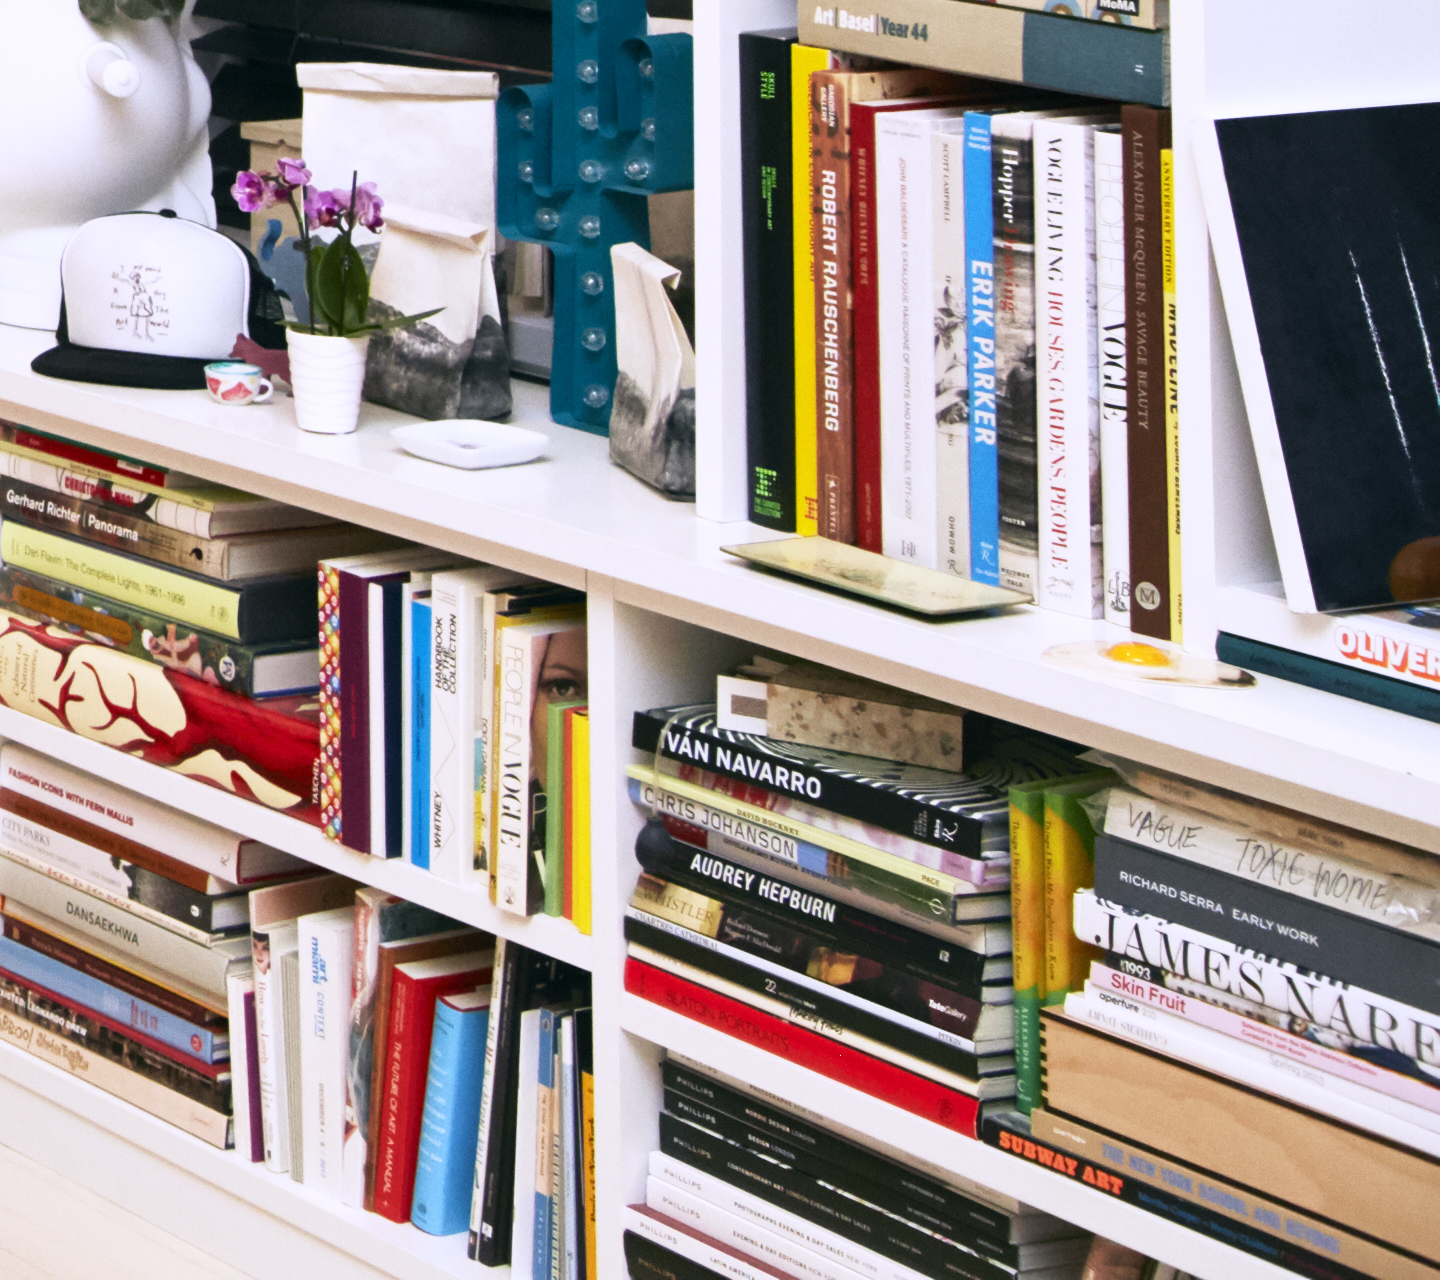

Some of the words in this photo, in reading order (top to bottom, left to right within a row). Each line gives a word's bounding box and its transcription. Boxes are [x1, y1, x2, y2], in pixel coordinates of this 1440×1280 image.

[814, 5, 834, 28] Art
[839, 8, 875, 34] Basel
[880, 16, 910, 40] Year
[910, 22, 929, 42] 44
[760, 70, 769, 100] STYLE
[768, 71, 776, 99] SKULL
[822, 169, 837, 255] ROBERT
[971, 259, 995, 328] ERIK
[822, 259, 839, 432] RAUSCHENBERG
[1102, 322, 1129, 423] VOGUE
[973, 335, 997, 447] PARKER
[6, 488, 46, 515] Gerhard
[46, 498, 81, 525] Richter
[87, 512, 139, 542] Panorama
[434, 616, 444, 689] HANDBOOK
[448, 613, 457, 695] COLLECTION
[8, 766, 40, 787] FASHION
[40, 778, 65, 798] ICONS
[65, 787, 85, 805] WITH
[85, 798, 106, 816] FERN
[106, 806, 135, 827] MALLIS
[311, 757, 321, 805] TASCHEN
[715, 745, 823, 800] NAVARRO
[433, 790, 443, 850] WHITNEY
[642, 783, 696, 821] CHRIS
[699, 806, 796, 861] JOHANSON
[690, 852, 755, 892] AUDREY
[758, 877, 836, 924] HEPBURN
[1127, 802, 1204, 851] VAGUE
[1235, 836, 1307, 887] TOXIC
[1312, 862, 1388, 915] WOME
[65, 900, 140, 947] DANSAEKHWA
[1119, 869, 1179, 900] RICHARD
[1179, 889, 1224, 916] SERRA
[1231, 907, 1276, 933] EARLY
[1275, 922, 1320, 948] WORK
[1093, 912, 1266, 1006] JAMES
[1120, 958, 1152, 983] 1993
[665, 988, 716, 1021] BEATON
[718, 1010, 791, 1052] PORTRAITS
[1098, 991, 1140, 1017] aperture
[1110, 972, 1146, 1001] Skin
[1147, 983, 1187, 1016] Fruit
[998, 1129, 1080, 1178] SUBWAY
[1081, 1165, 1125, 1197] ART
